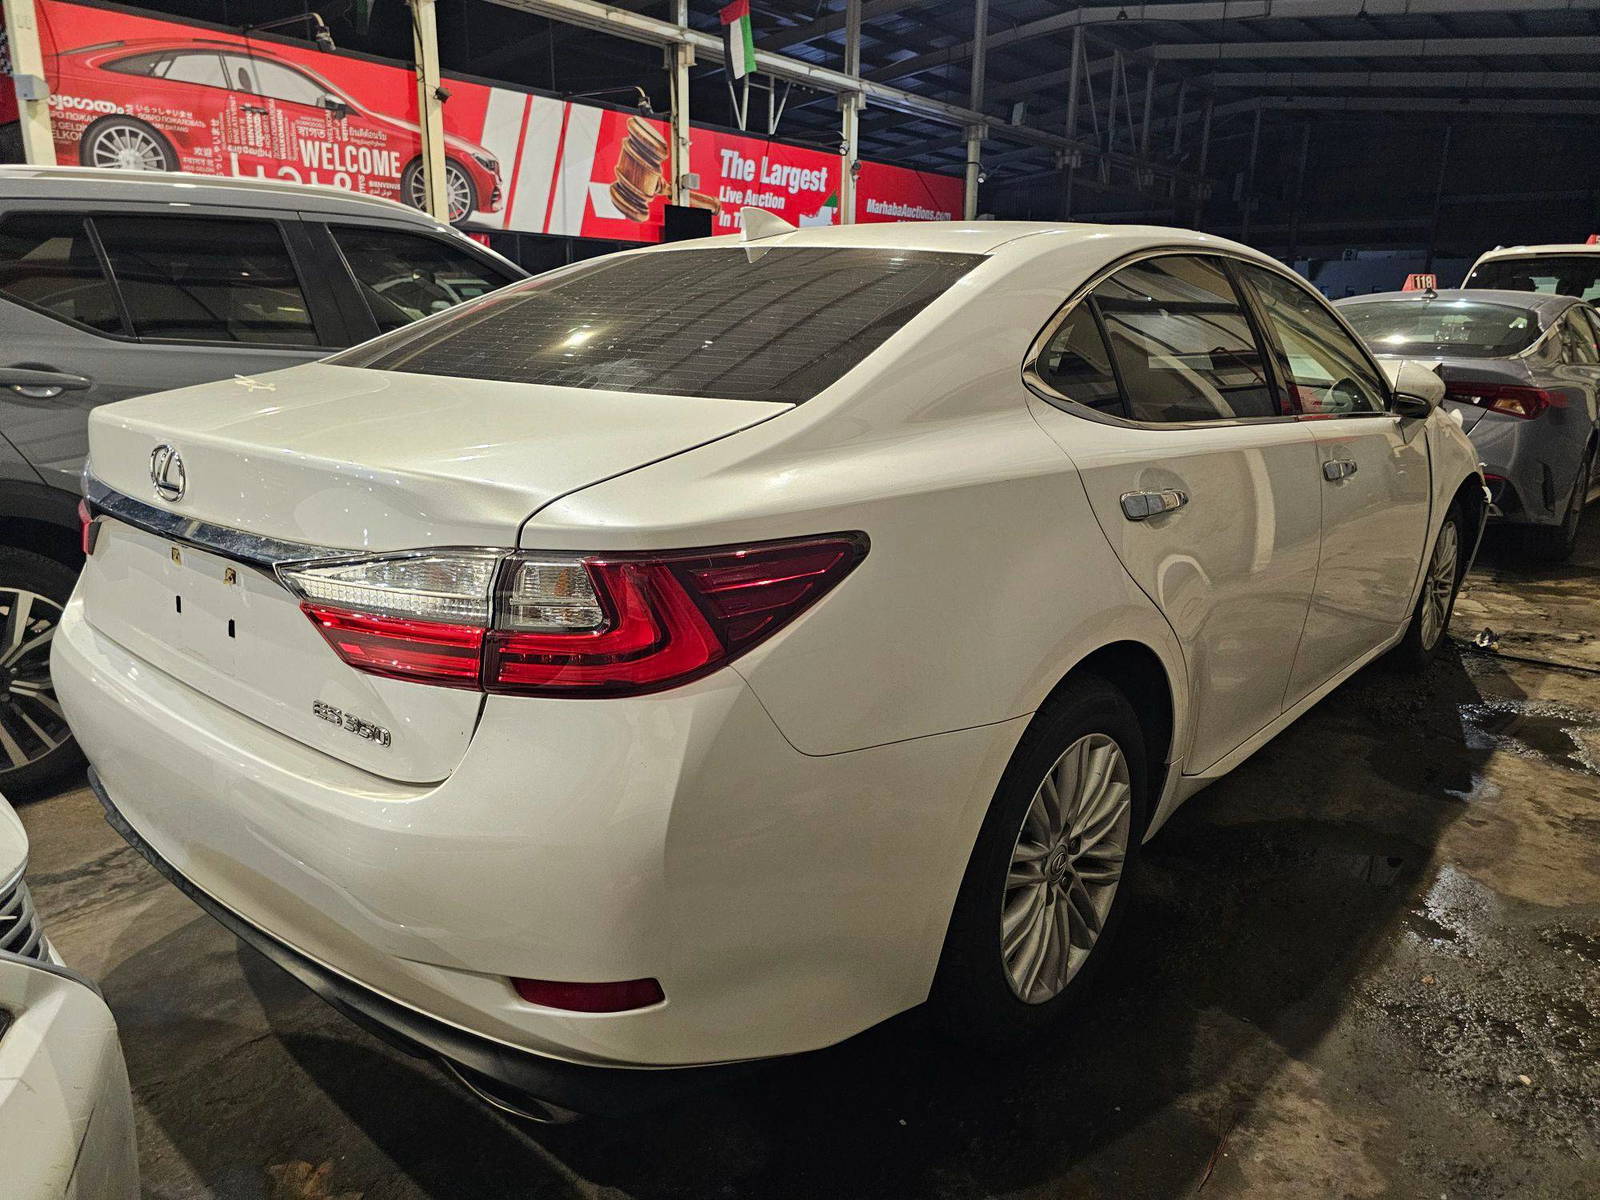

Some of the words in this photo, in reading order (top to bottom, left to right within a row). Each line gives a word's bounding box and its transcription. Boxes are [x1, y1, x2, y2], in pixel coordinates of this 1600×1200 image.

[298, 139, 402, 178] WELCOME
[721, 148, 756, 181] The
[760, 155, 828, 194] Largest
[719, 185, 743, 204] Live
[744, 189, 786, 210] Auction
[866, 198, 952, 221] MarhabaAuctions.com
[719, 210, 731, 227] In
[1415, 276, 1433, 289] 118
[313, 699, 343, 728] ES
[343, 712, 392, 749] 350
